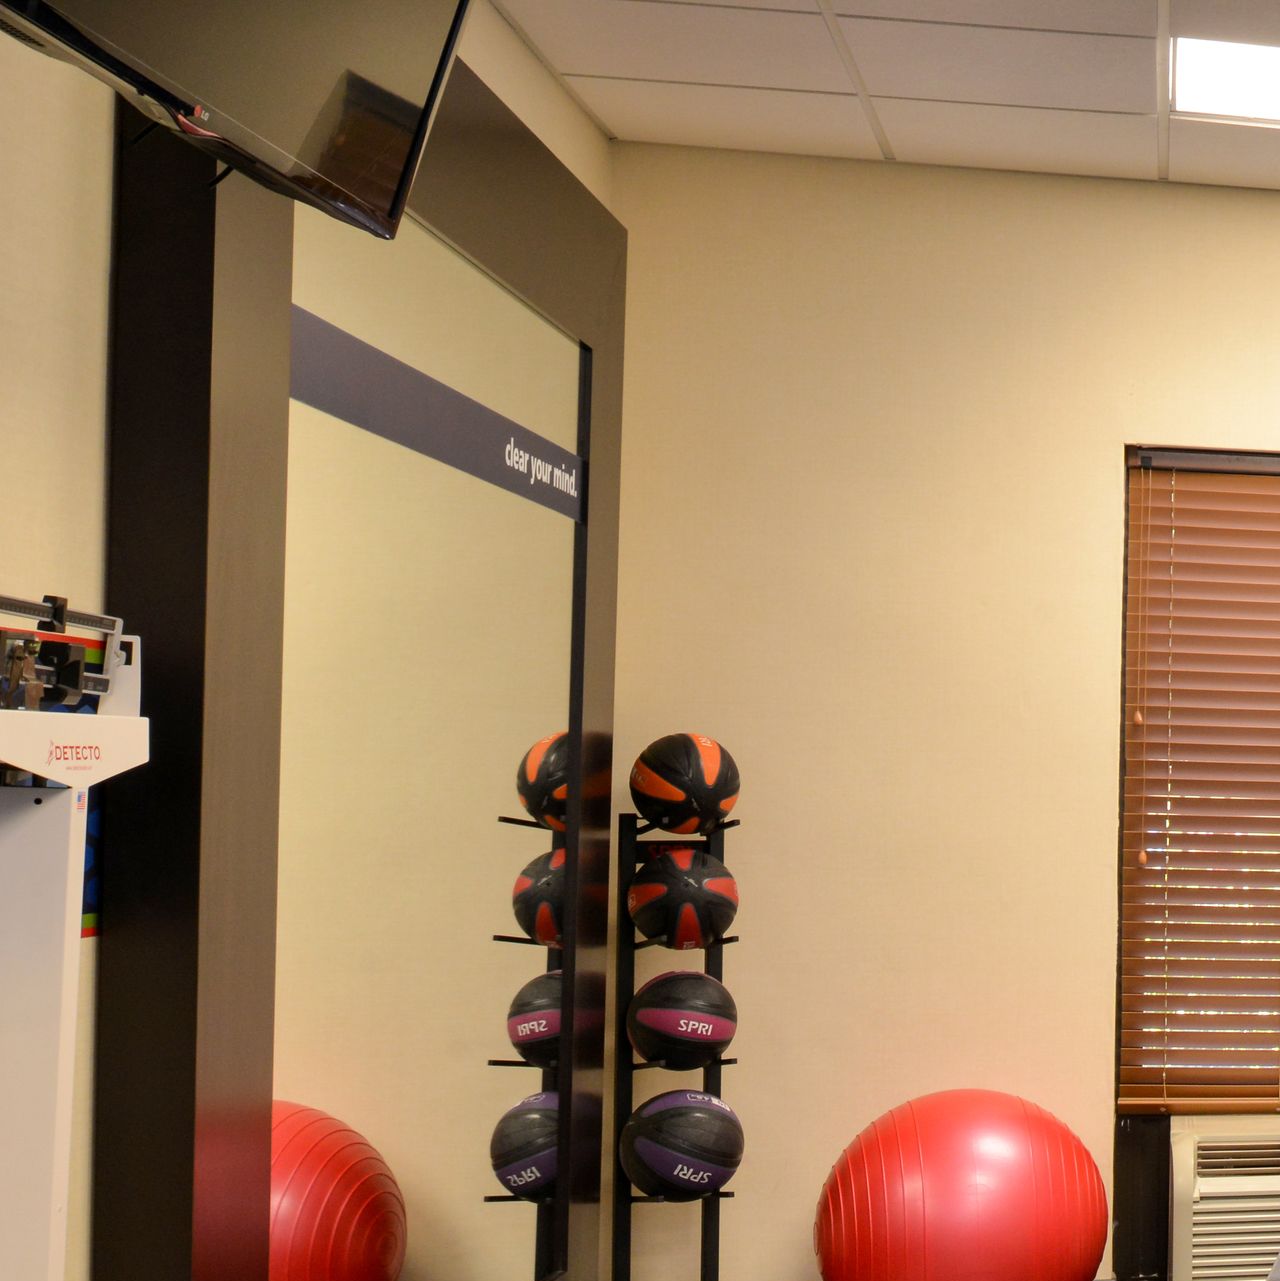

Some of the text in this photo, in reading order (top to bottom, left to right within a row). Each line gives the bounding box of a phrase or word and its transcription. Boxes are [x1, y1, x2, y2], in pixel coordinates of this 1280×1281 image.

[505, 437, 577, 498] clear your mind.
[54, 745, 100, 761] DETECTO
[678, 1019, 713, 1036] SPRI
[673, 1163, 712, 1184] SPRI
